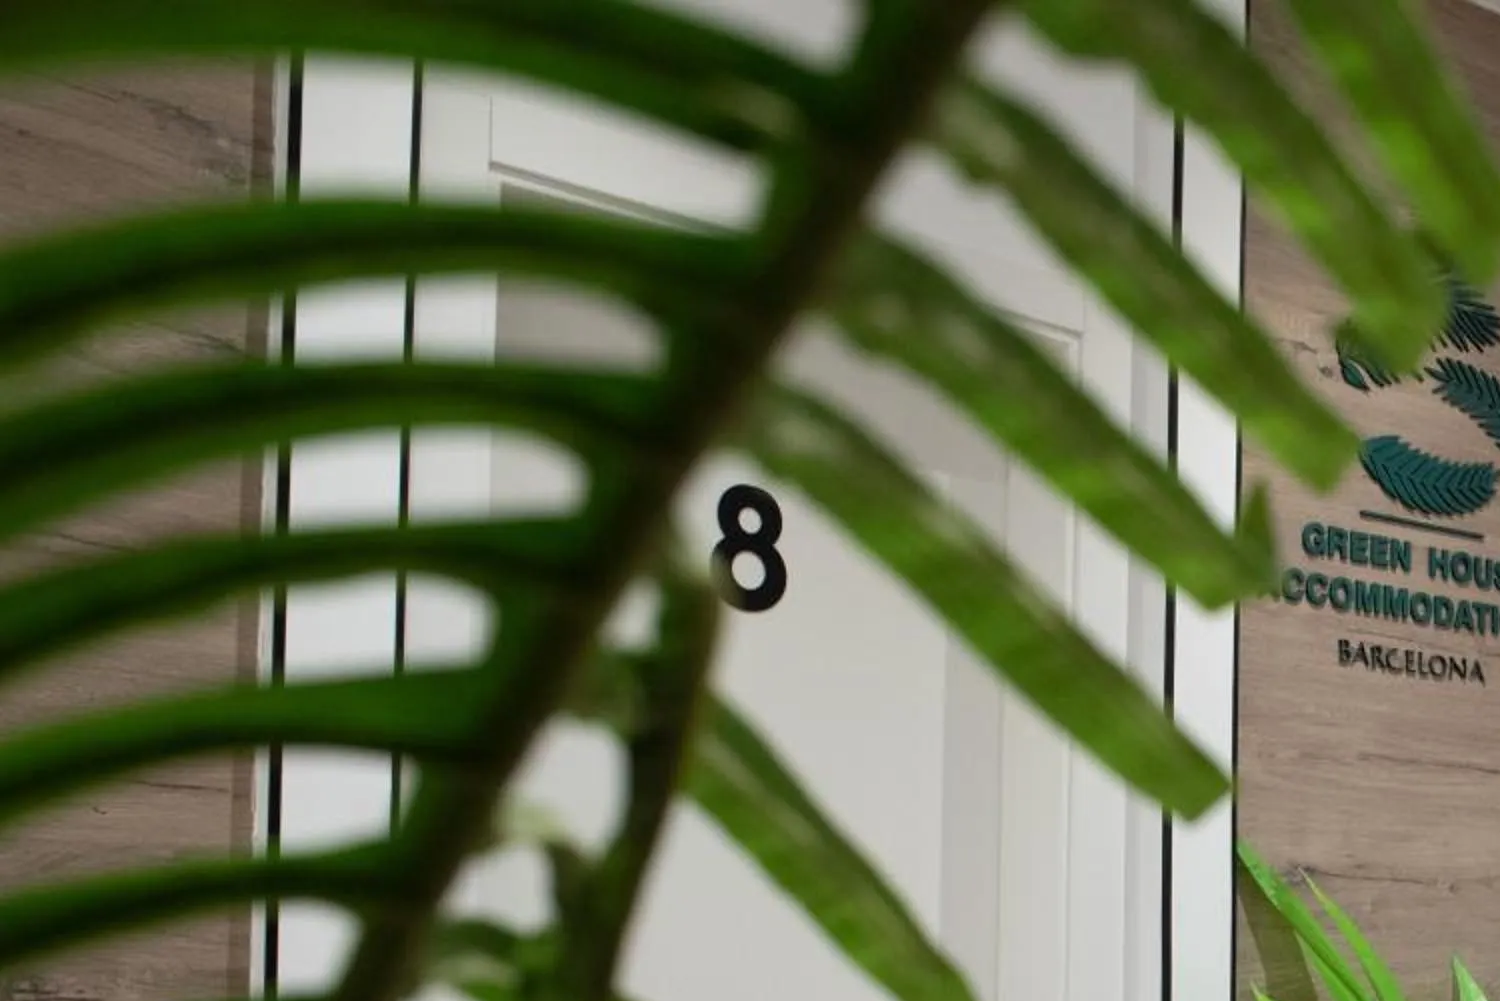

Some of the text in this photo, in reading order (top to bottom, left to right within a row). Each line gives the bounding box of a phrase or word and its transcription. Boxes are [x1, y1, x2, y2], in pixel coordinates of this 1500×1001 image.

[710, 484, 787, 613] 8
[1301, 521, 1411, 572] GREEN
[1337, 638, 1486, 687] BARCELONA
